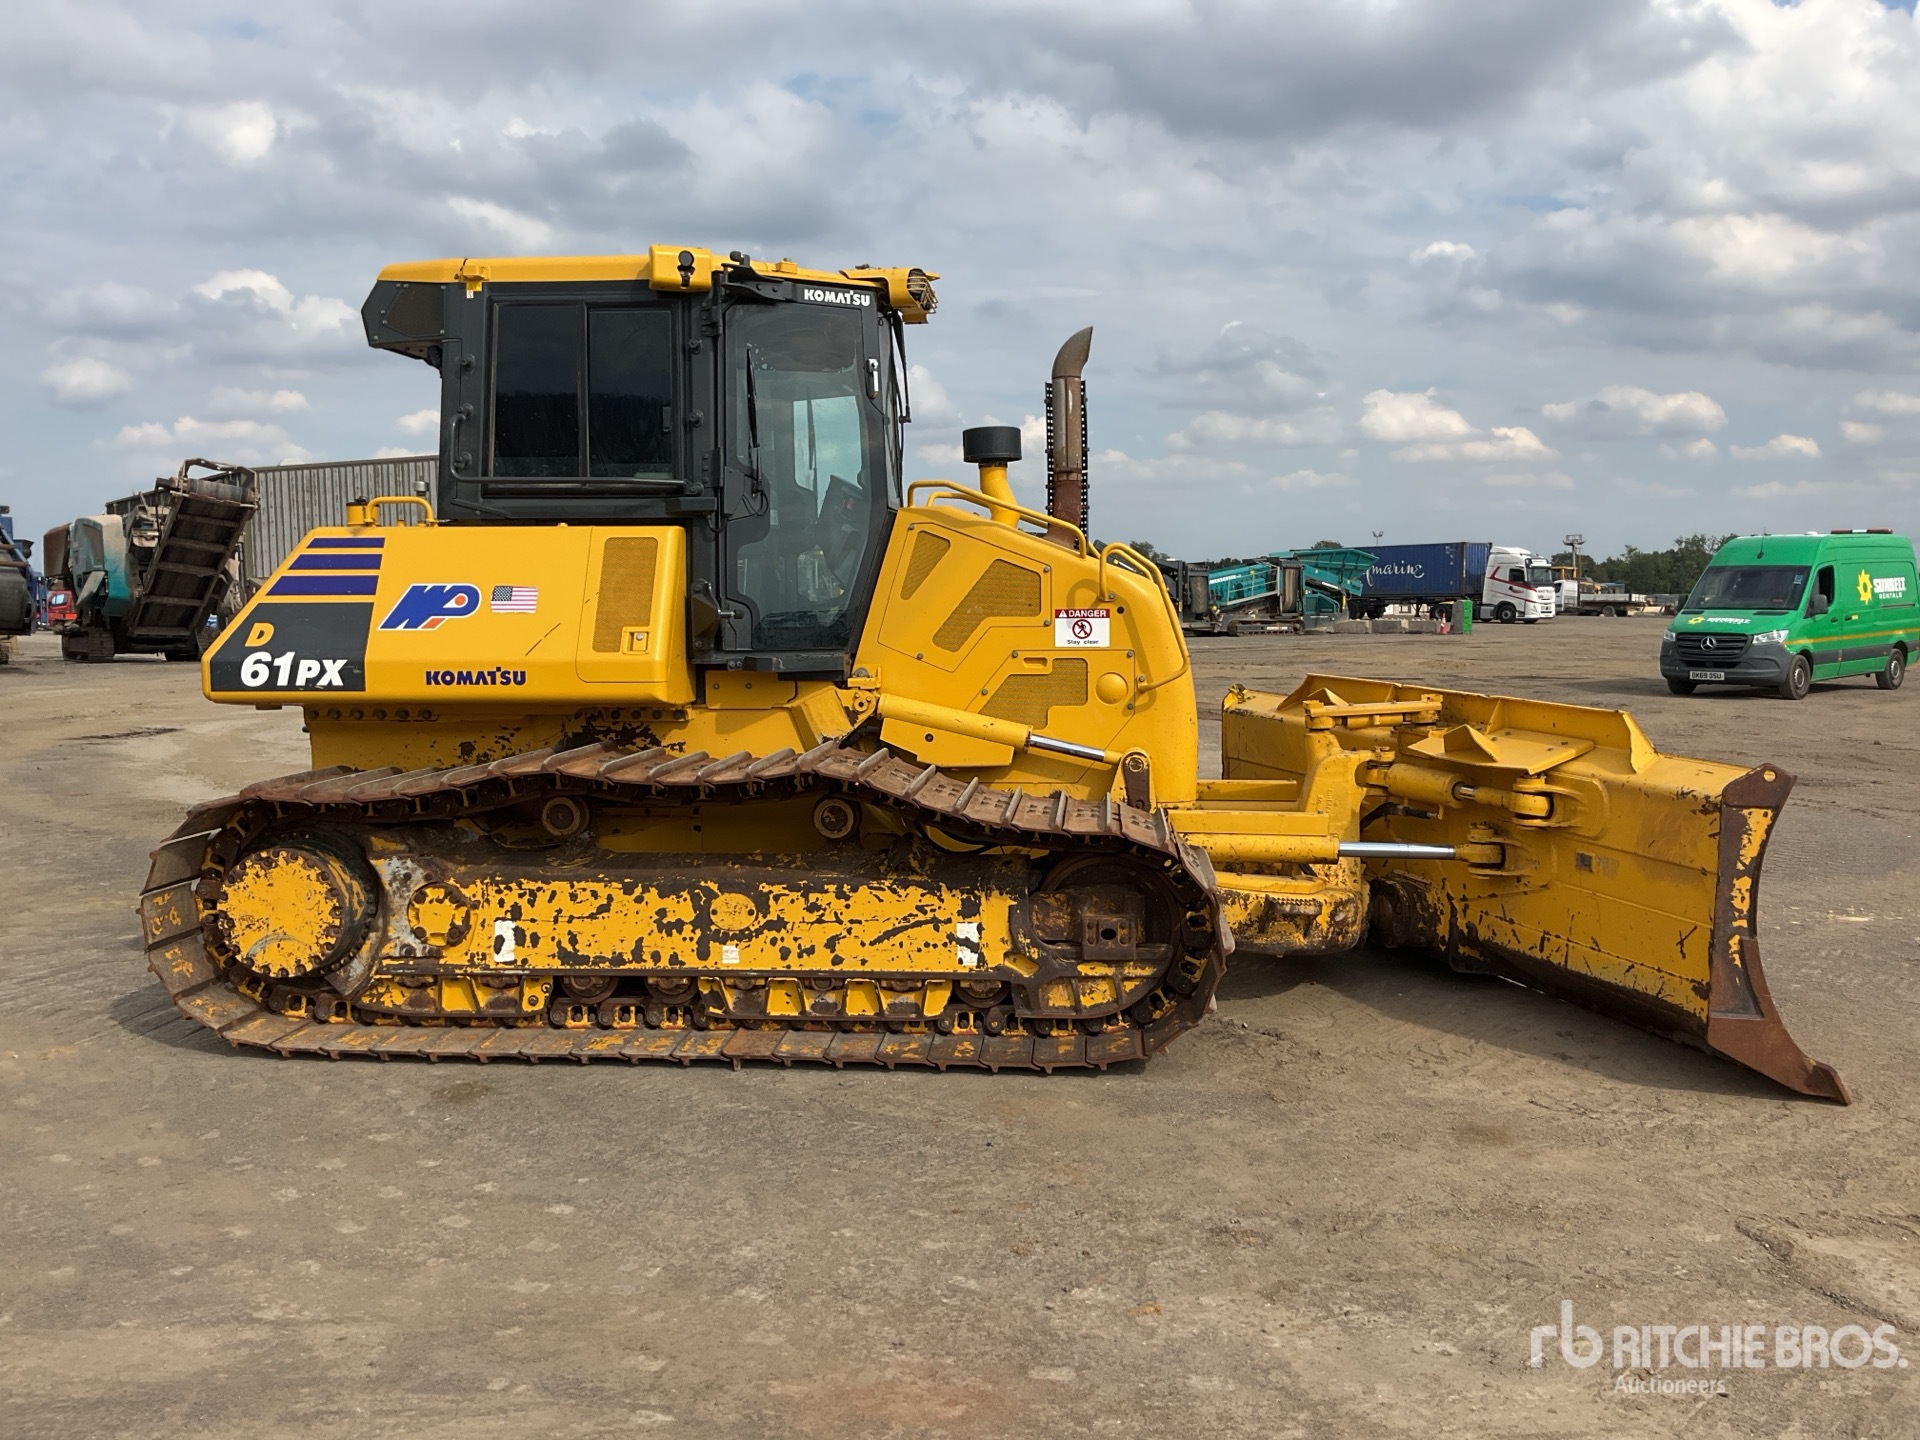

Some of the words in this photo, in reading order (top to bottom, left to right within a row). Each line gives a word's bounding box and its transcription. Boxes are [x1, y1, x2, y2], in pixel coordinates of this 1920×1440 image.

[804, 289, 870, 306] KOMATSU
[1872, 576, 1907, 593] SUNBELT
[1068, 609, 1107, 618] DANGER
[244, 622, 275, 647] D
[425, 666, 527, 686] KOMATSU
